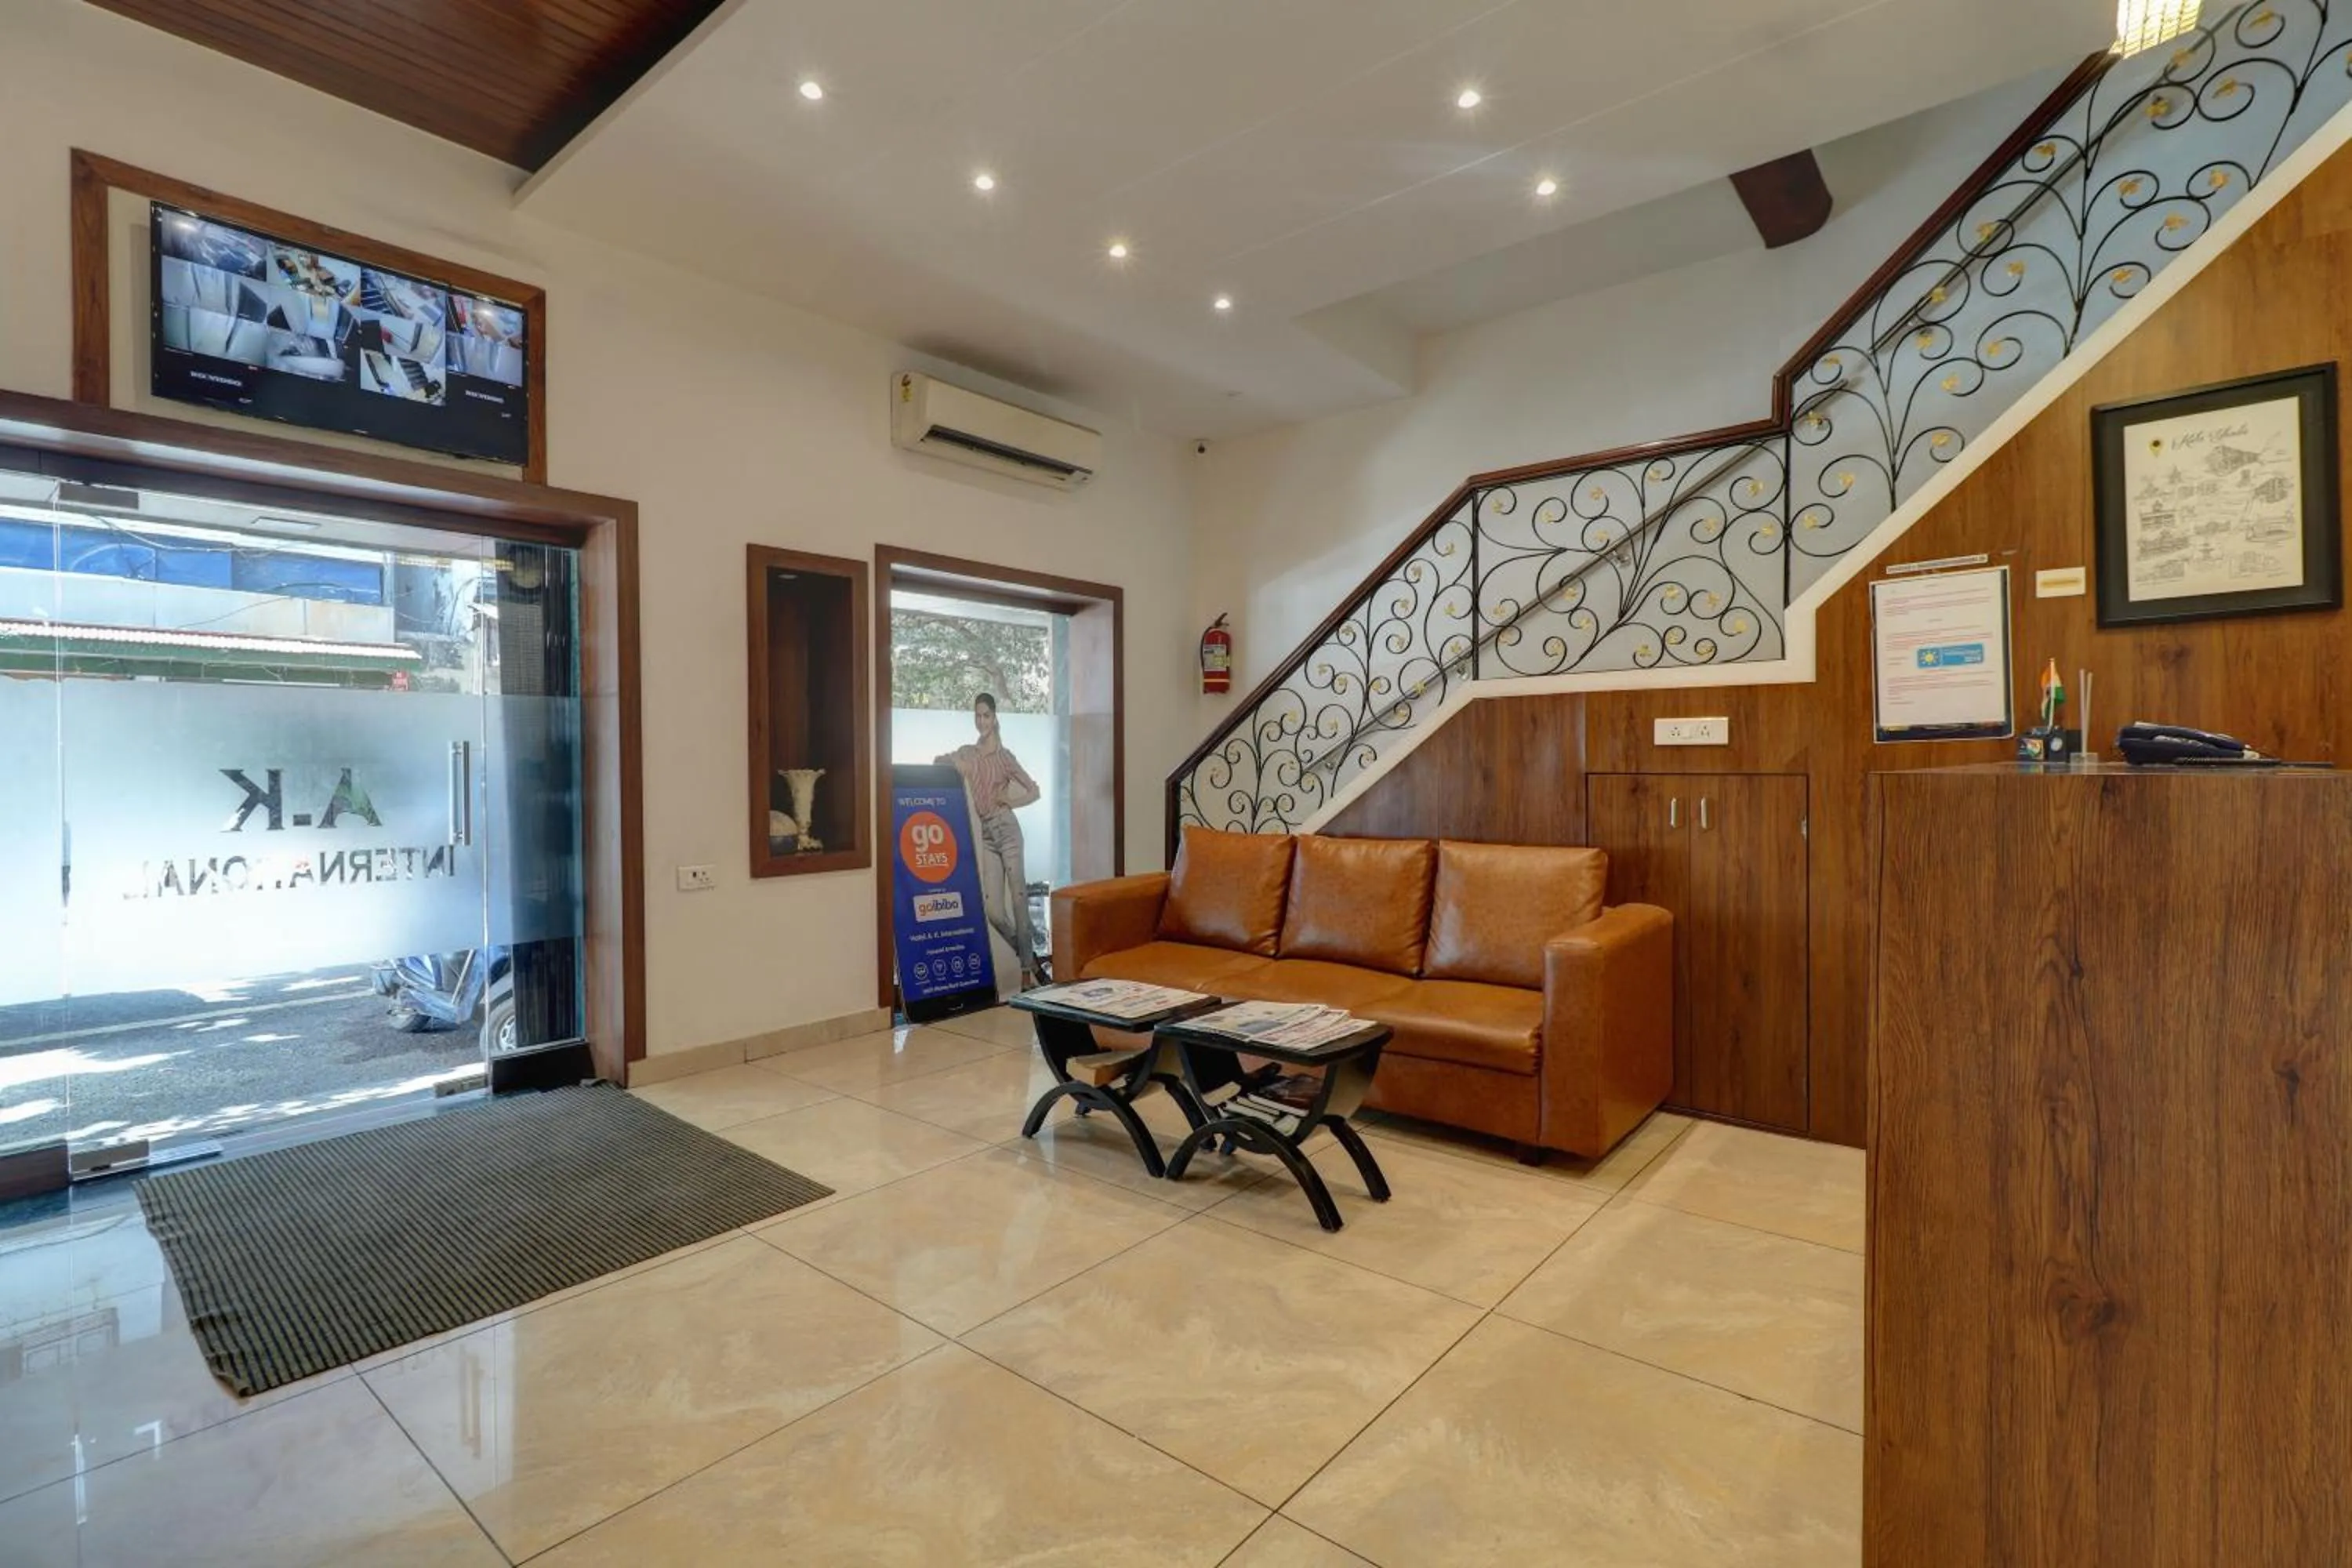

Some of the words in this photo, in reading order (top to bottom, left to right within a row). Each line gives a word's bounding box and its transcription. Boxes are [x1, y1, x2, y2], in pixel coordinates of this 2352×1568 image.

[912, 824, 944, 853] go
[915, 852, 948, 866] STAYS
[919, 898, 959, 916] goibibo
